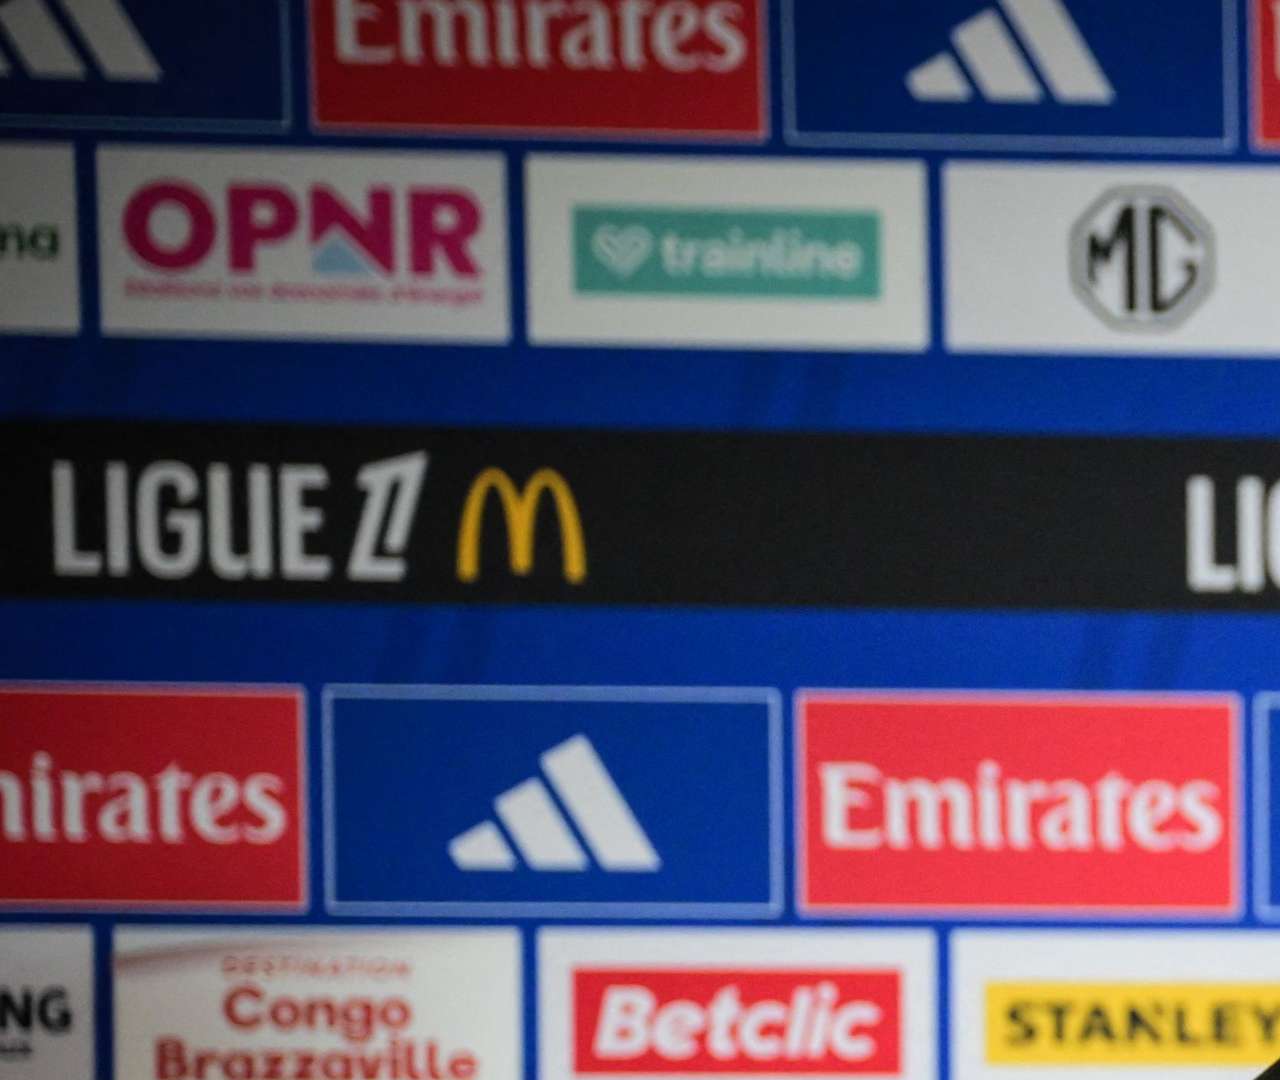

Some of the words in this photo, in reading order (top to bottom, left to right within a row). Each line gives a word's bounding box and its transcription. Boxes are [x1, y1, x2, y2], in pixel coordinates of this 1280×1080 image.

[334, 0, 747, 73] Emirates
[120, 177, 482, 277] OPNR
[660, 228, 863, 281] trainline
[1087, 204, 1197, 314] MG
[52, 461, 331, 580] LIGUE
[0, 750, 288, 844] irates
[819, 759, 1223, 851] Emirates
[221, 984, 413, 1042] Congo
[593, 982, 882, 1060] Betclic
